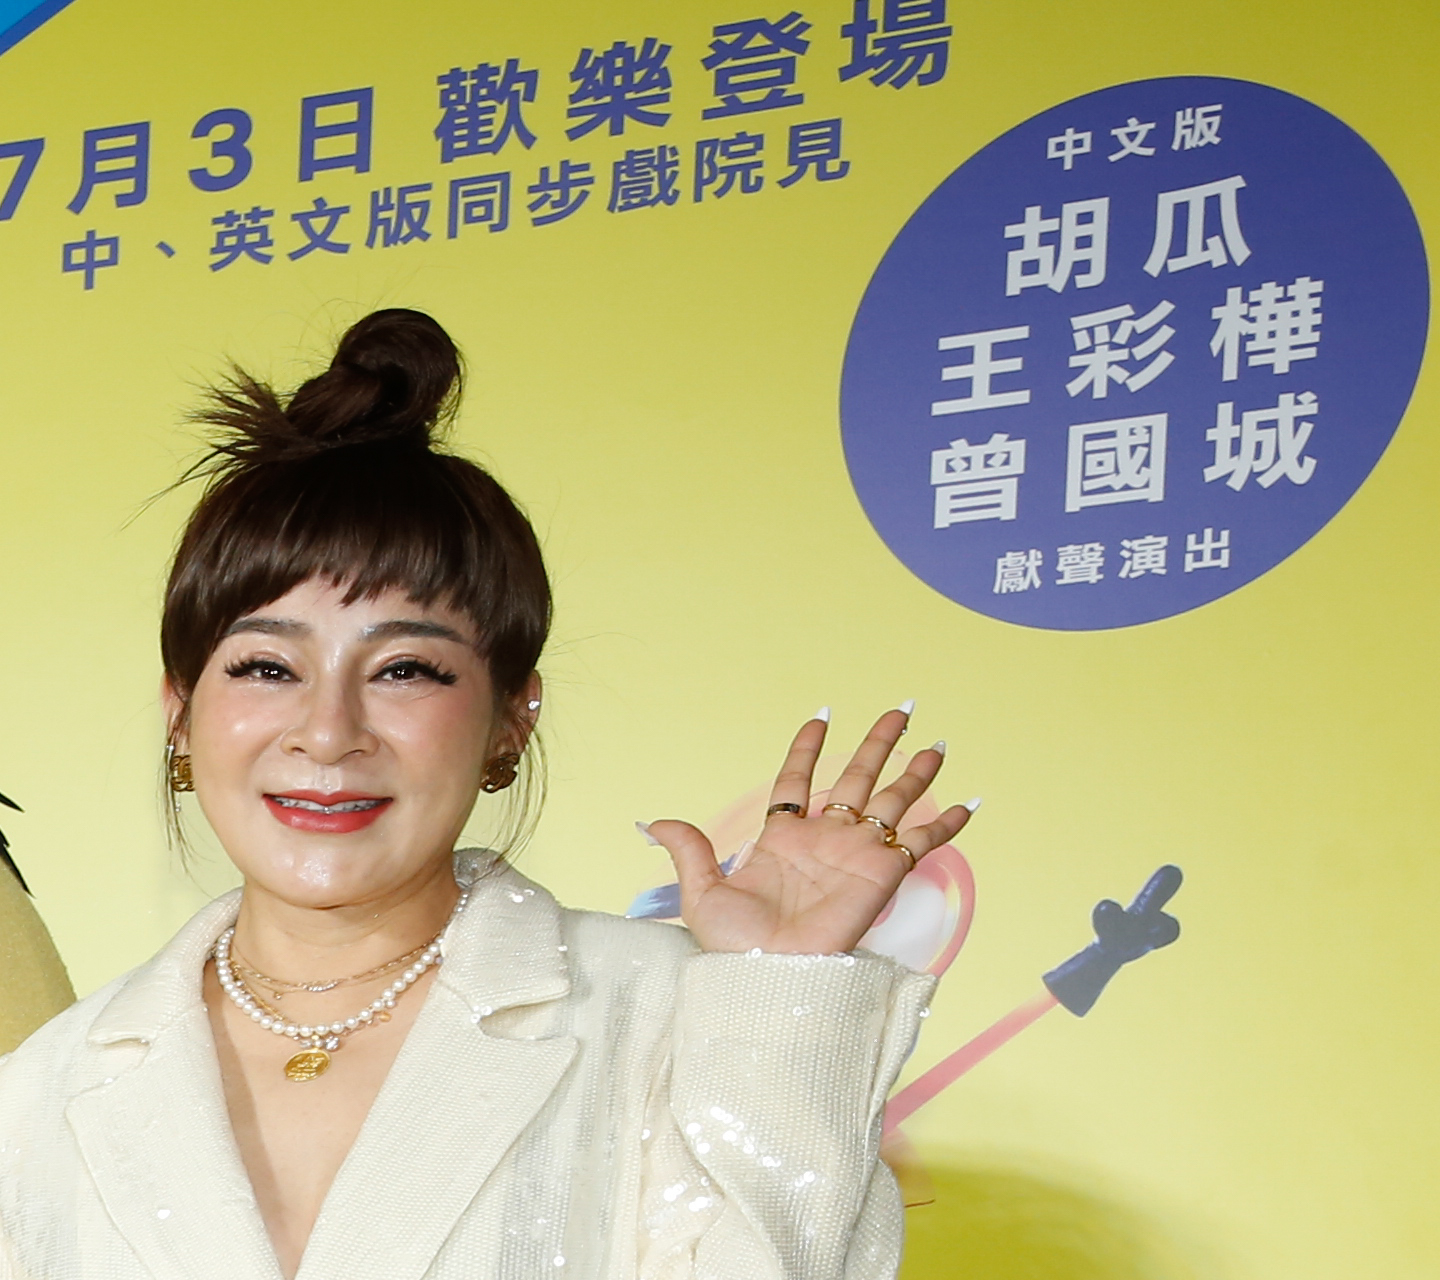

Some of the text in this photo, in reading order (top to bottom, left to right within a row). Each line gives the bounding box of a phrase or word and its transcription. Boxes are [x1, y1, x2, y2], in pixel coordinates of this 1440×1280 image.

[432, 0, 954, 164] 歡樂登場
[1046, 102, 1224, 171] 中文版
[60, 117, 852, 292] 中、英文版同步戲院見
[1002, 173, 1253, 297] 胡瓜
[930, 275, 1325, 417] 王彩樺
[928, 390, 1320, 529] 曾國城
[992, 526, 1232, 594] 獻聲演出
